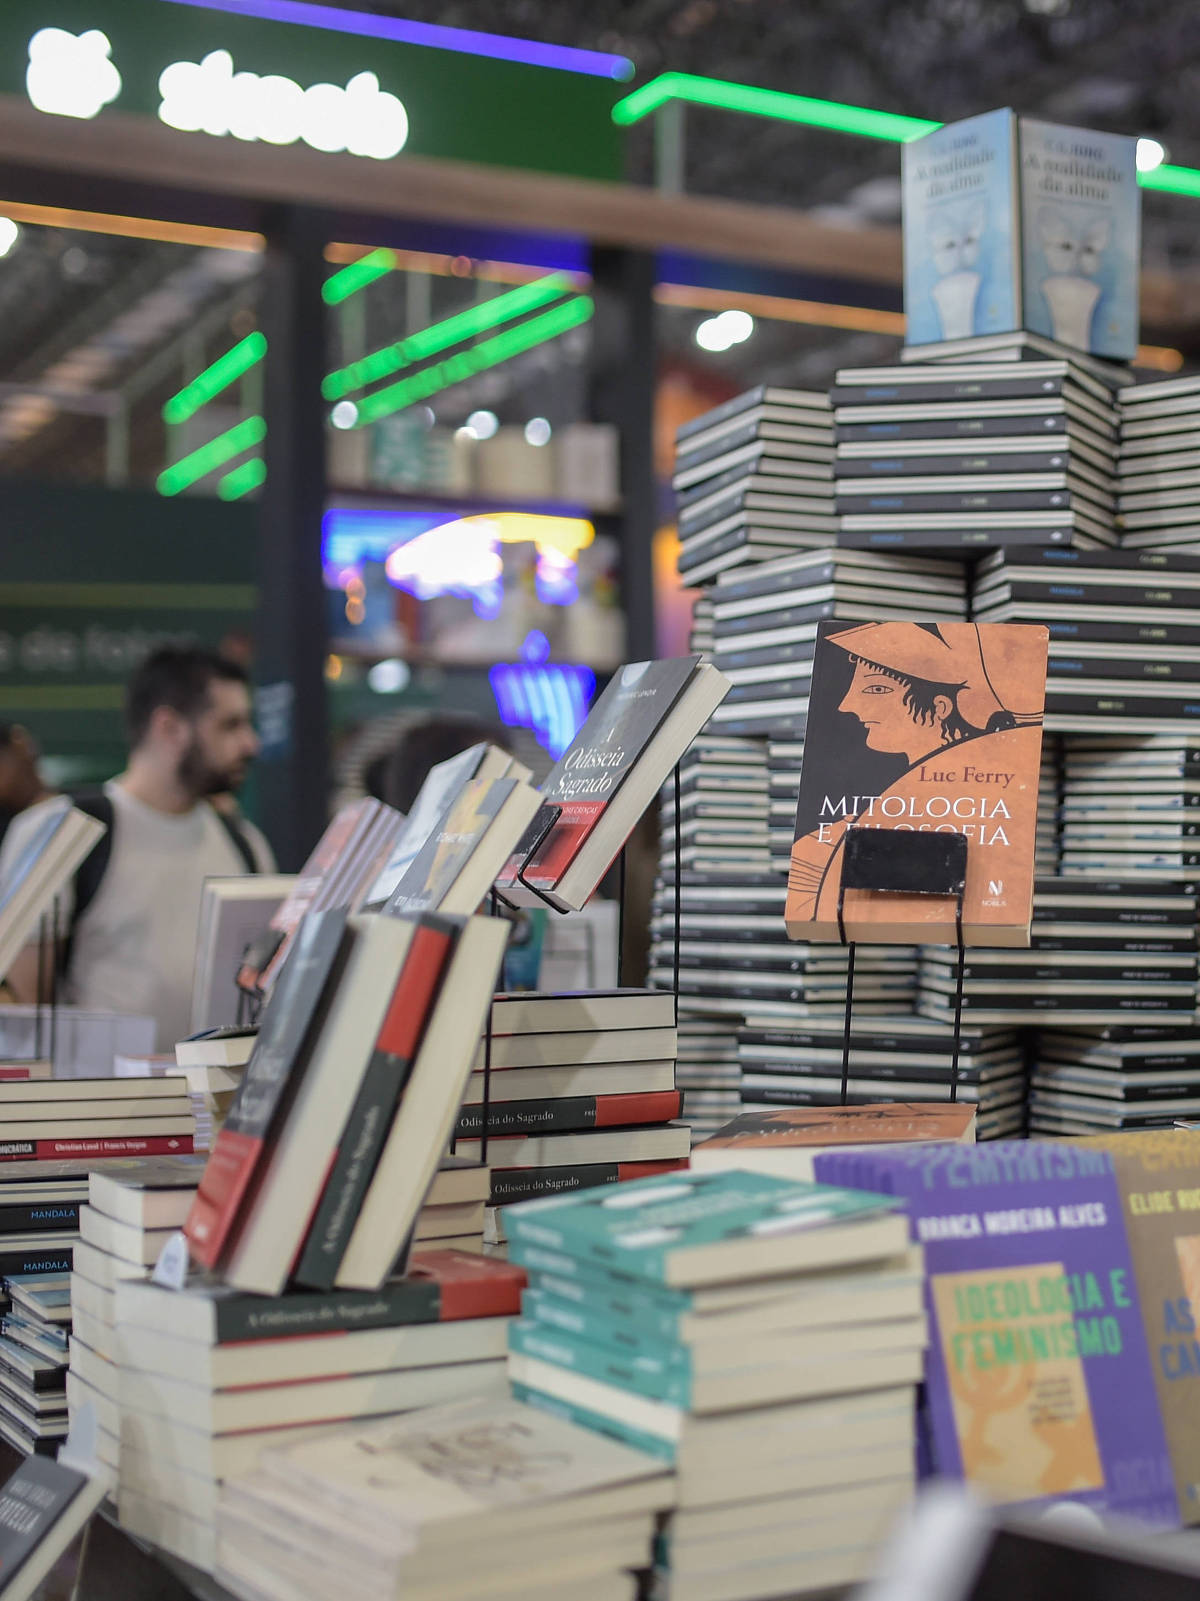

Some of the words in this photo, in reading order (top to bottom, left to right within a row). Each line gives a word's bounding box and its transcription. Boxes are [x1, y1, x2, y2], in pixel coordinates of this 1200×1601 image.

[564, 746, 625, 771] Odisseia
[920, 766, 955, 783] Luc
[963, 767, 1016, 789] Ferry
[819, 795, 1012, 819] MITOLOGIA
[817, 822, 833, 844] E
[460, 1114, 500, 1128] Odiseia
[516, 1111, 554, 1125] Sagrado
[495, 1182, 531, 1194] Odisseia
[545, 1177, 579, 1191] Sagrado
[32, 1209, 75, 1219] MANDALA
[24, 1261, 68, 1271] MANDALA
[953, 1272, 1105, 1323] IDEOLOGIA
[1108, 1269, 1131, 1309] E
[1163, 1296, 1196, 1336] AS
[951, 1315, 1123, 1372] FEMINISMO
